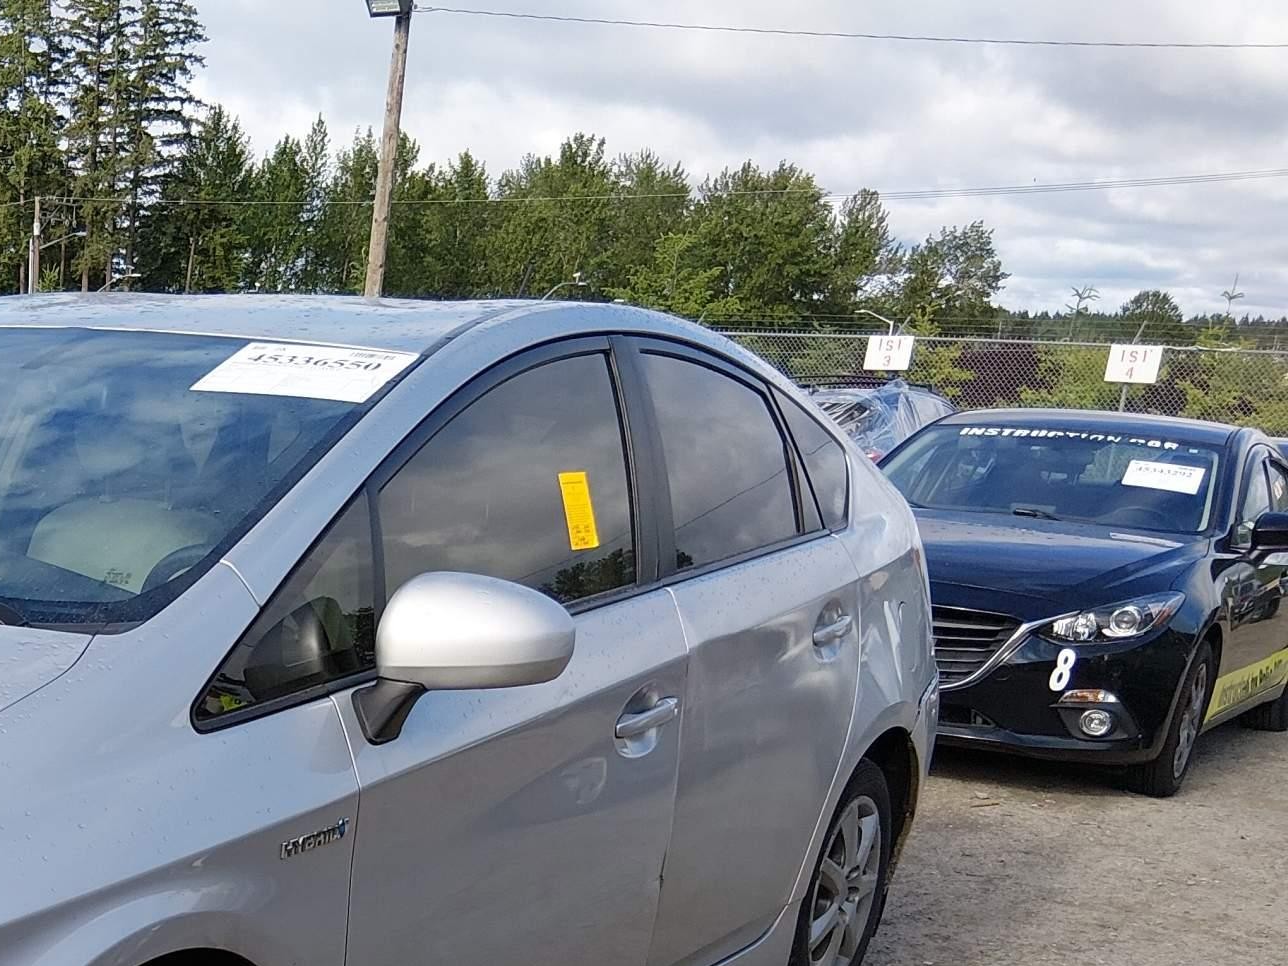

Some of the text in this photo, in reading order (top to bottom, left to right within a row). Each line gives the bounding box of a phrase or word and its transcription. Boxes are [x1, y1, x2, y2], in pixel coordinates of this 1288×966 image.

[248, 353, 382, 371] 45336550
[882, 354, 891, 367] 3
[1125, 366, 1134, 379] 4
[1048, 649, 1078, 691] 8
